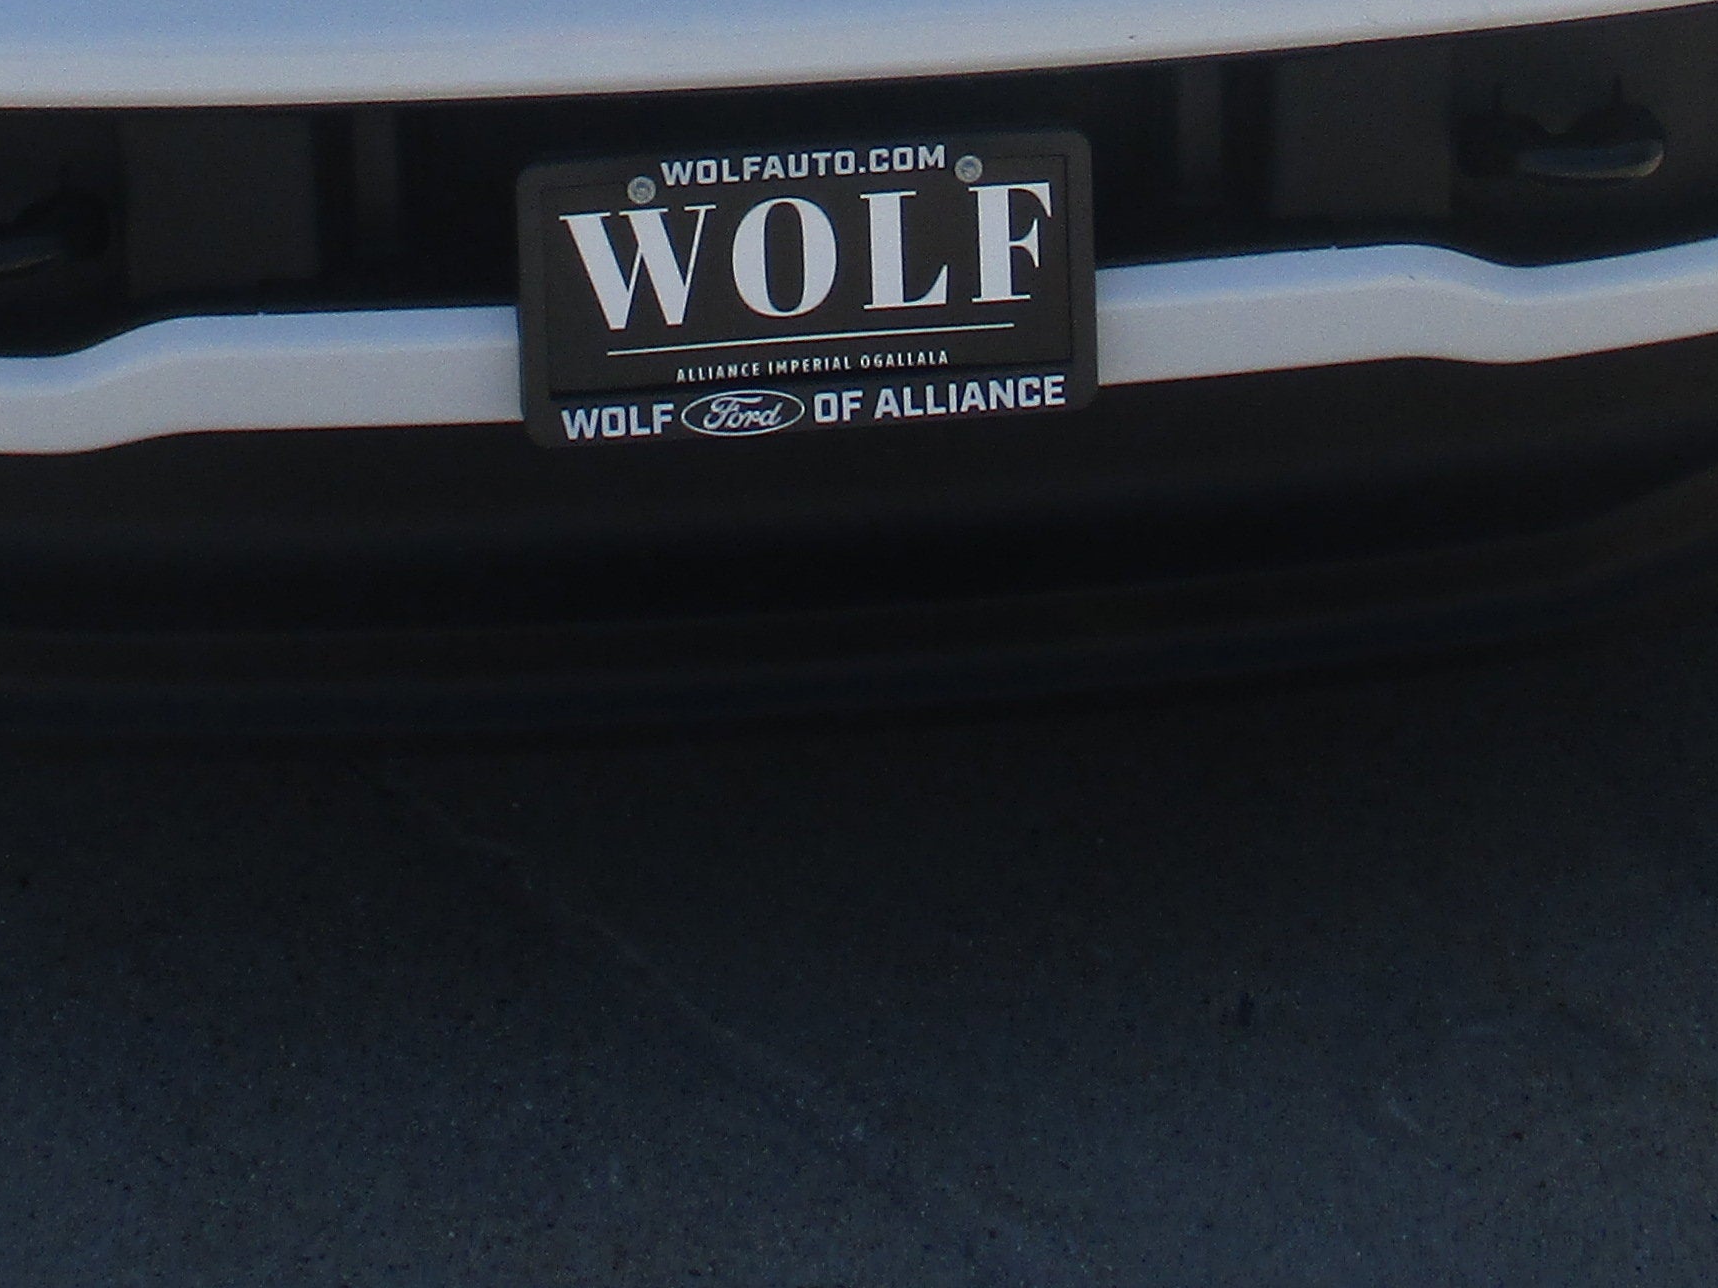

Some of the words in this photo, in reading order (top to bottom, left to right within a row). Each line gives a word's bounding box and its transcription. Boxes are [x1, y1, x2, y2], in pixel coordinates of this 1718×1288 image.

[660, 144, 947, 187] WOLFAUTO.COM
[558, 182, 1053, 331] WOLF
[675, 362, 761, 384] ALLIANCE
[767, 355, 852, 375] IMPERIAL
[859, 349, 950, 369] OGALLALA
[560, 402, 675, 441] WOLF
[702, 394, 782, 430] Ford
[813, 389, 864, 424] OF
[873, 374, 1066, 421] ALLIANCE
